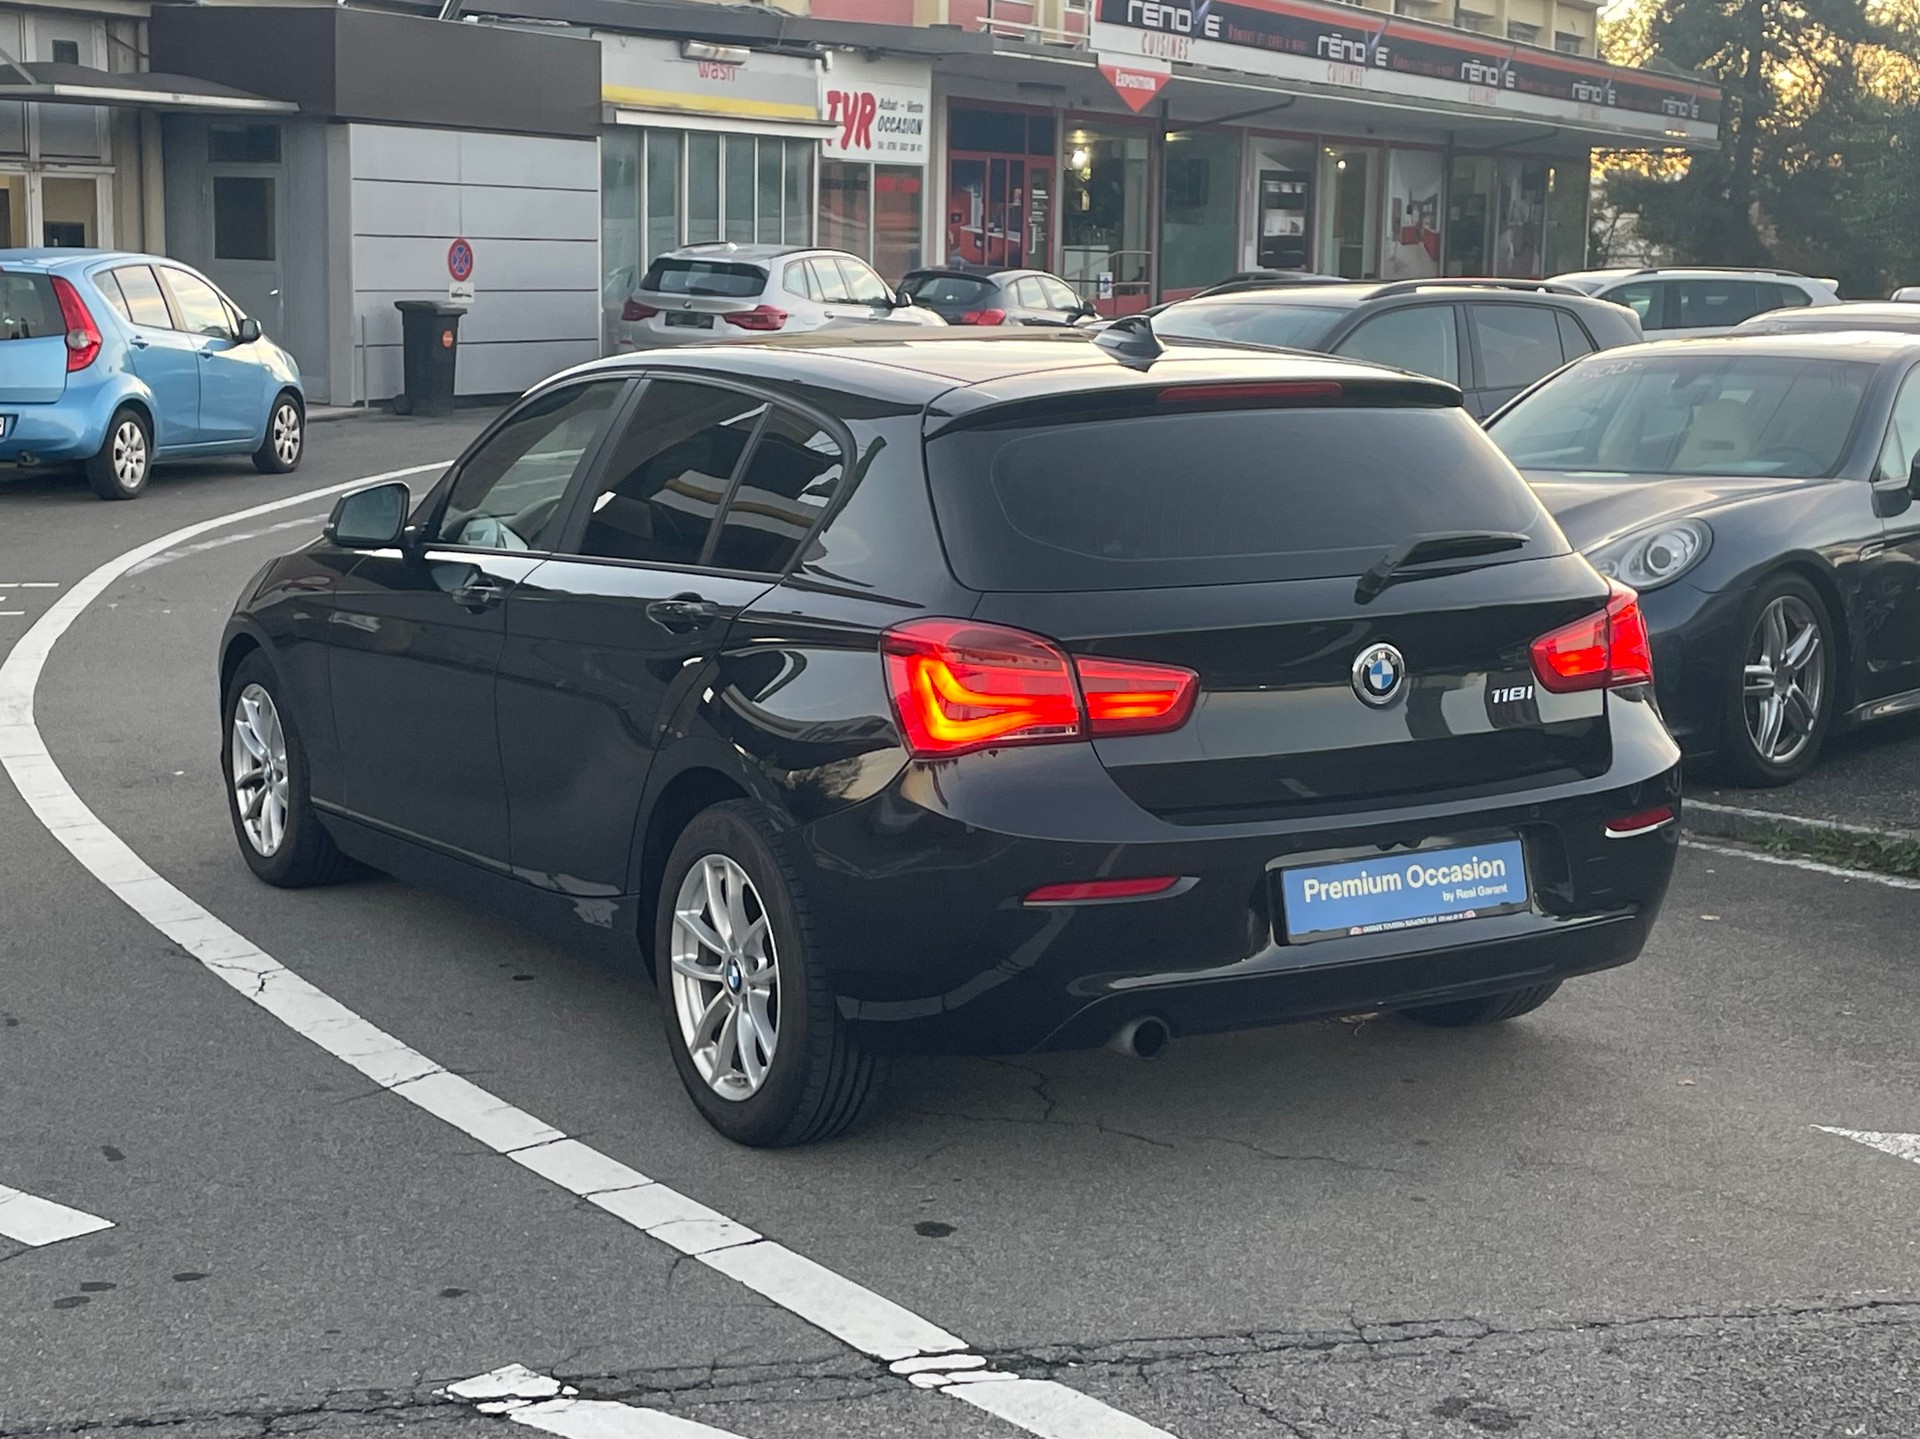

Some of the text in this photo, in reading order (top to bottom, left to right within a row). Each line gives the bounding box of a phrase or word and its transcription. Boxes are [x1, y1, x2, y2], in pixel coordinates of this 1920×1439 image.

[827, 90, 876, 150] TYR
[877, 115, 923, 136] OCCASION
[1303, 856, 1506, 903] Premium Occasion
[1442, 883, 1509, 903] by Real Garant
